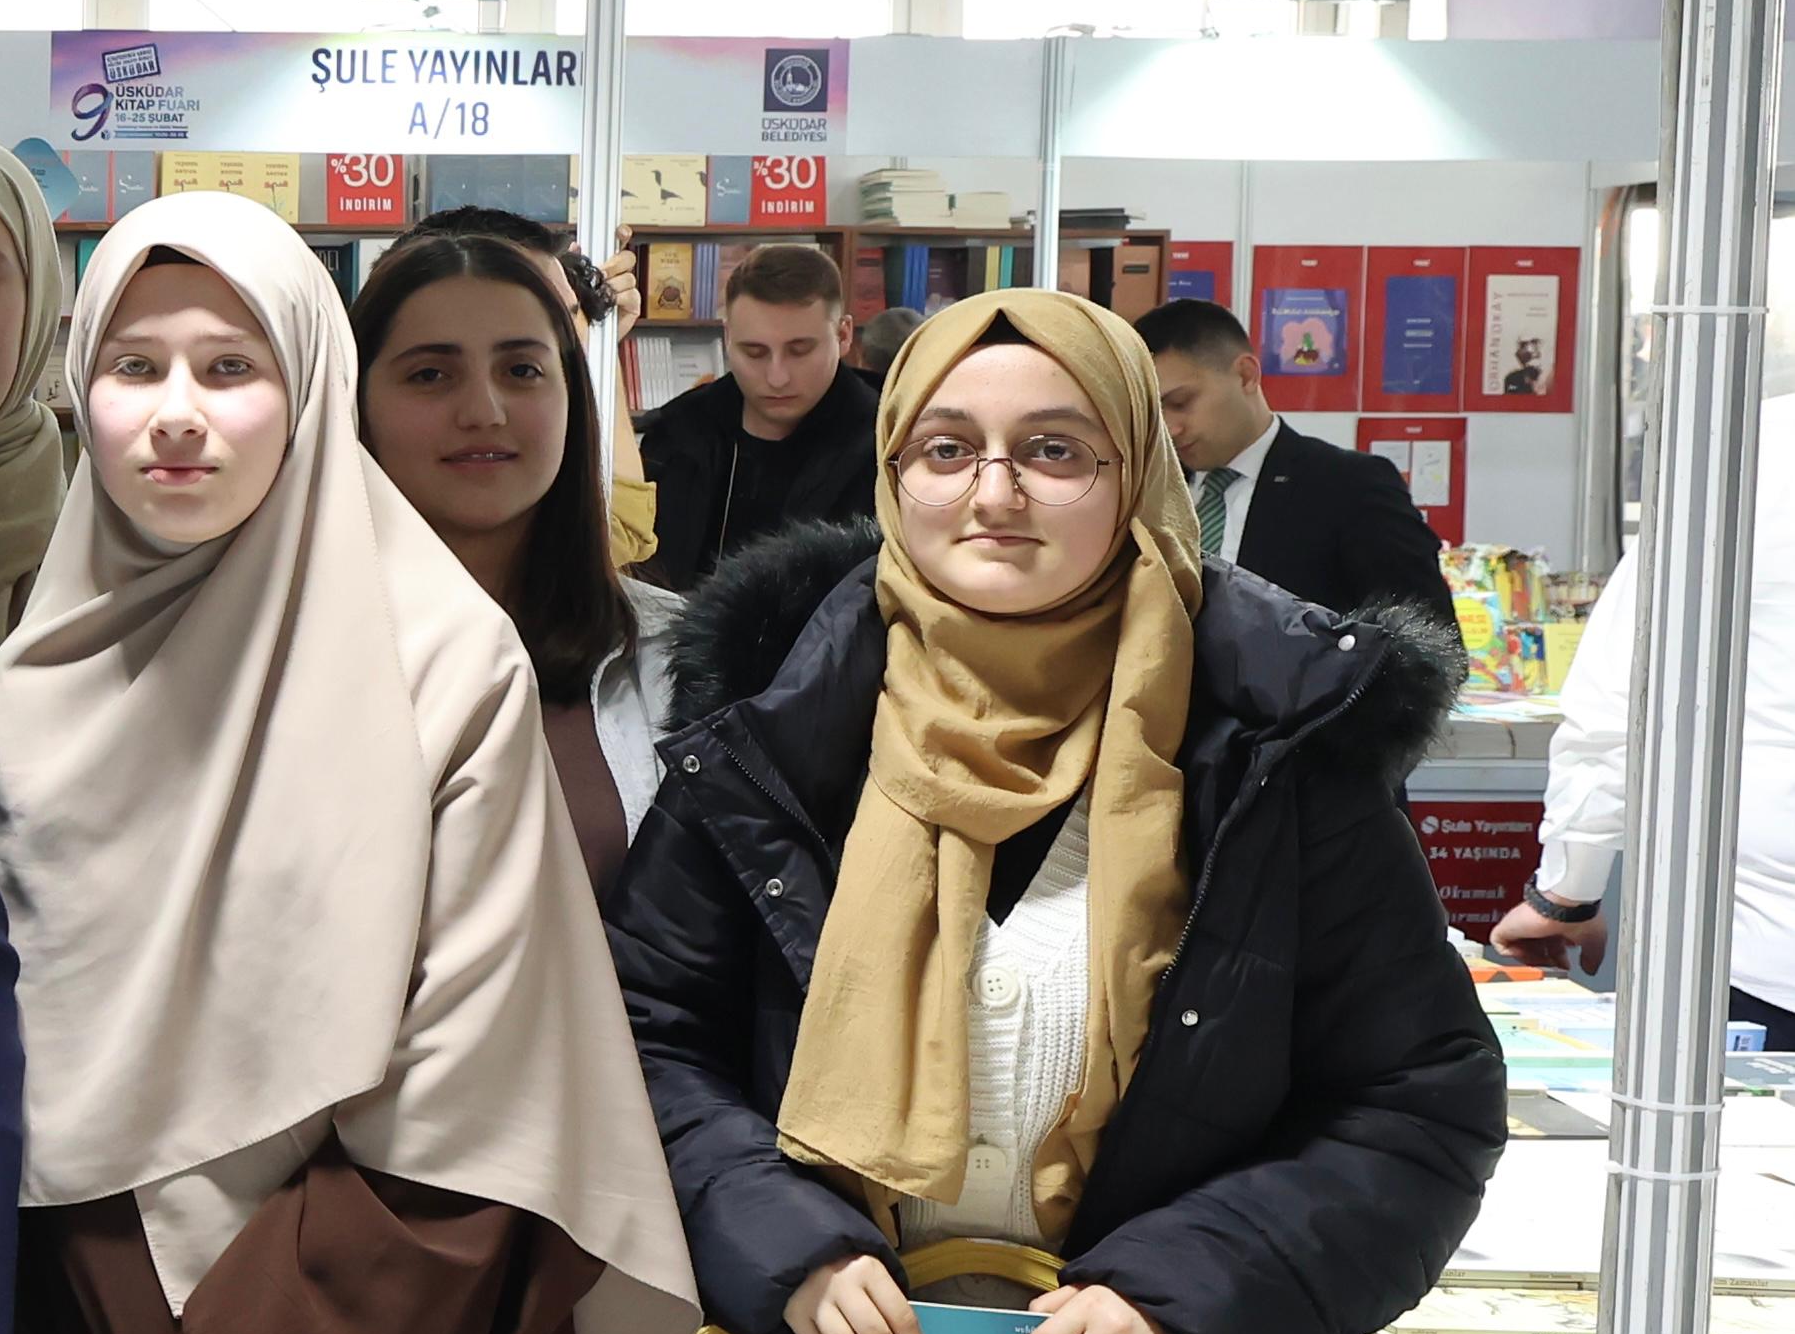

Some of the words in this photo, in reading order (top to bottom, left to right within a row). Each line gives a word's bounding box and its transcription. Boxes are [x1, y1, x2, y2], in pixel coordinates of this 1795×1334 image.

[311, 48, 398, 92] ŞULE
[115, 83, 185, 98] ÜSKÜDAR
[114, 113, 147, 123] 16-25
[148, 113, 185, 124] ŞUBAT
[158, 100, 201, 112] FUARI
[408, 97, 490, 139] A/18
[330, 154, 396, 188] %30
[753, 156, 817, 190] %30
[1453, 846, 1522, 862] YAŞINDA
